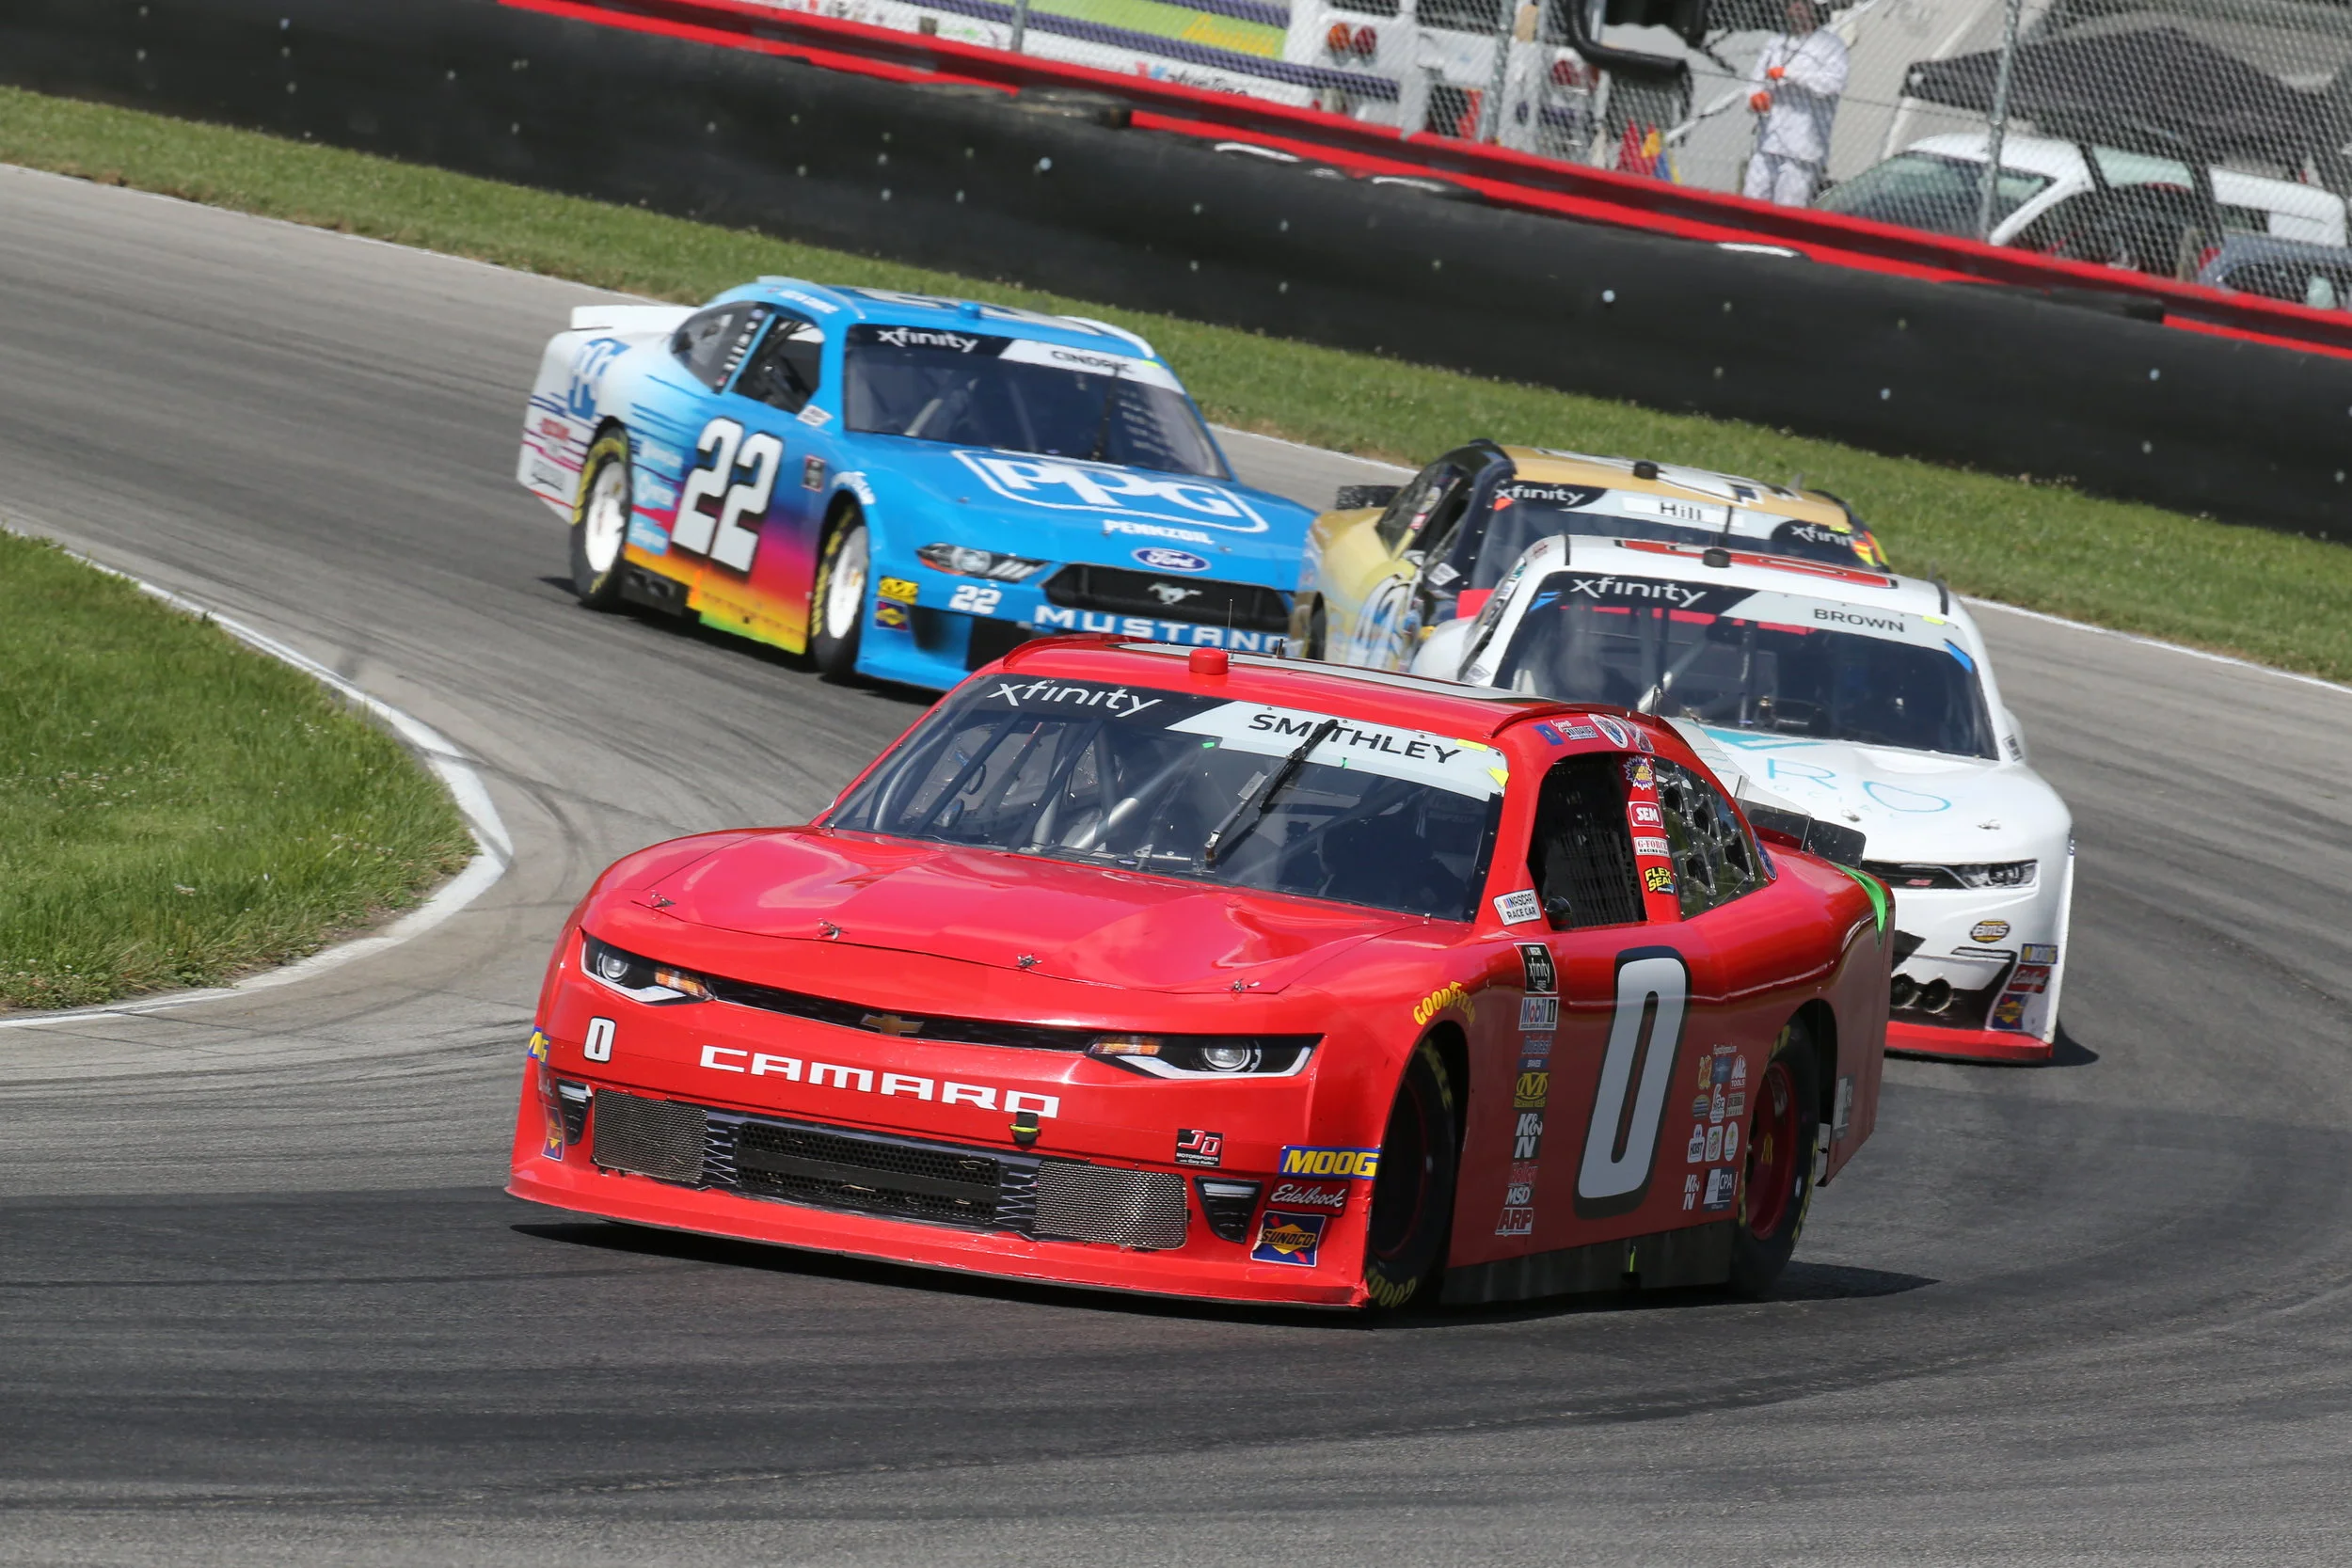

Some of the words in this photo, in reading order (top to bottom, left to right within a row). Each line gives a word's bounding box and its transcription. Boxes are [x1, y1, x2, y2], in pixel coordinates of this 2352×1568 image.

[876, 326, 978, 354] xfinity
[1050, 349, 1135, 375] CINDRC
[670, 416, 784, 574] 22
[978, 457, 1243, 517] PPG
[1494, 483, 1586, 507] xfinity
[1660, 500, 1703, 522] Hill
[1790, 523, 1855, 546] xfinit
[948, 584, 1003, 615] 22
[1570, 575, 1708, 609] xfinity
[1813, 607, 1906, 635] BROWN
[987, 679, 1165, 719] xfinity
[1248, 713, 1463, 765] SMTHLEY
[1635, 807, 1660, 823] SEM
[1638, 839, 1668, 850] G-FORCE
[1645, 866, 1672, 882] FLEX
[1648, 876, 1672, 893] SEAL
[1506, 908, 1525, 919] RACE
[1525, 906, 1536, 916] CAR
[1509, 893, 1534, 907] NASCAR
[1528, 957, 1550, 984] xfinity
[1522, 998, 1547, 1023] Mobil
[583, 1016, 616, 1063] 0
[699, 1044, 1061, 1119] CAMARO
[1577, 956, 1687, 1200] 0
[1731, 1079, 1745, 1087] TOOLS
[1176, 1152, 1219, 1162] MOTORSPORTS
[1282, 1149, 1380, 1178] MOOG
[1720, 1173, 1733, 1190] CPA
[1270, 1183, 1346, 1208] Edelbrock
[1505, 1186, 1531, 1206] MSD
[1498, 1208, 1534, 1233] ARP
[1262, 1228, 1315, 1246] SUNOCO
